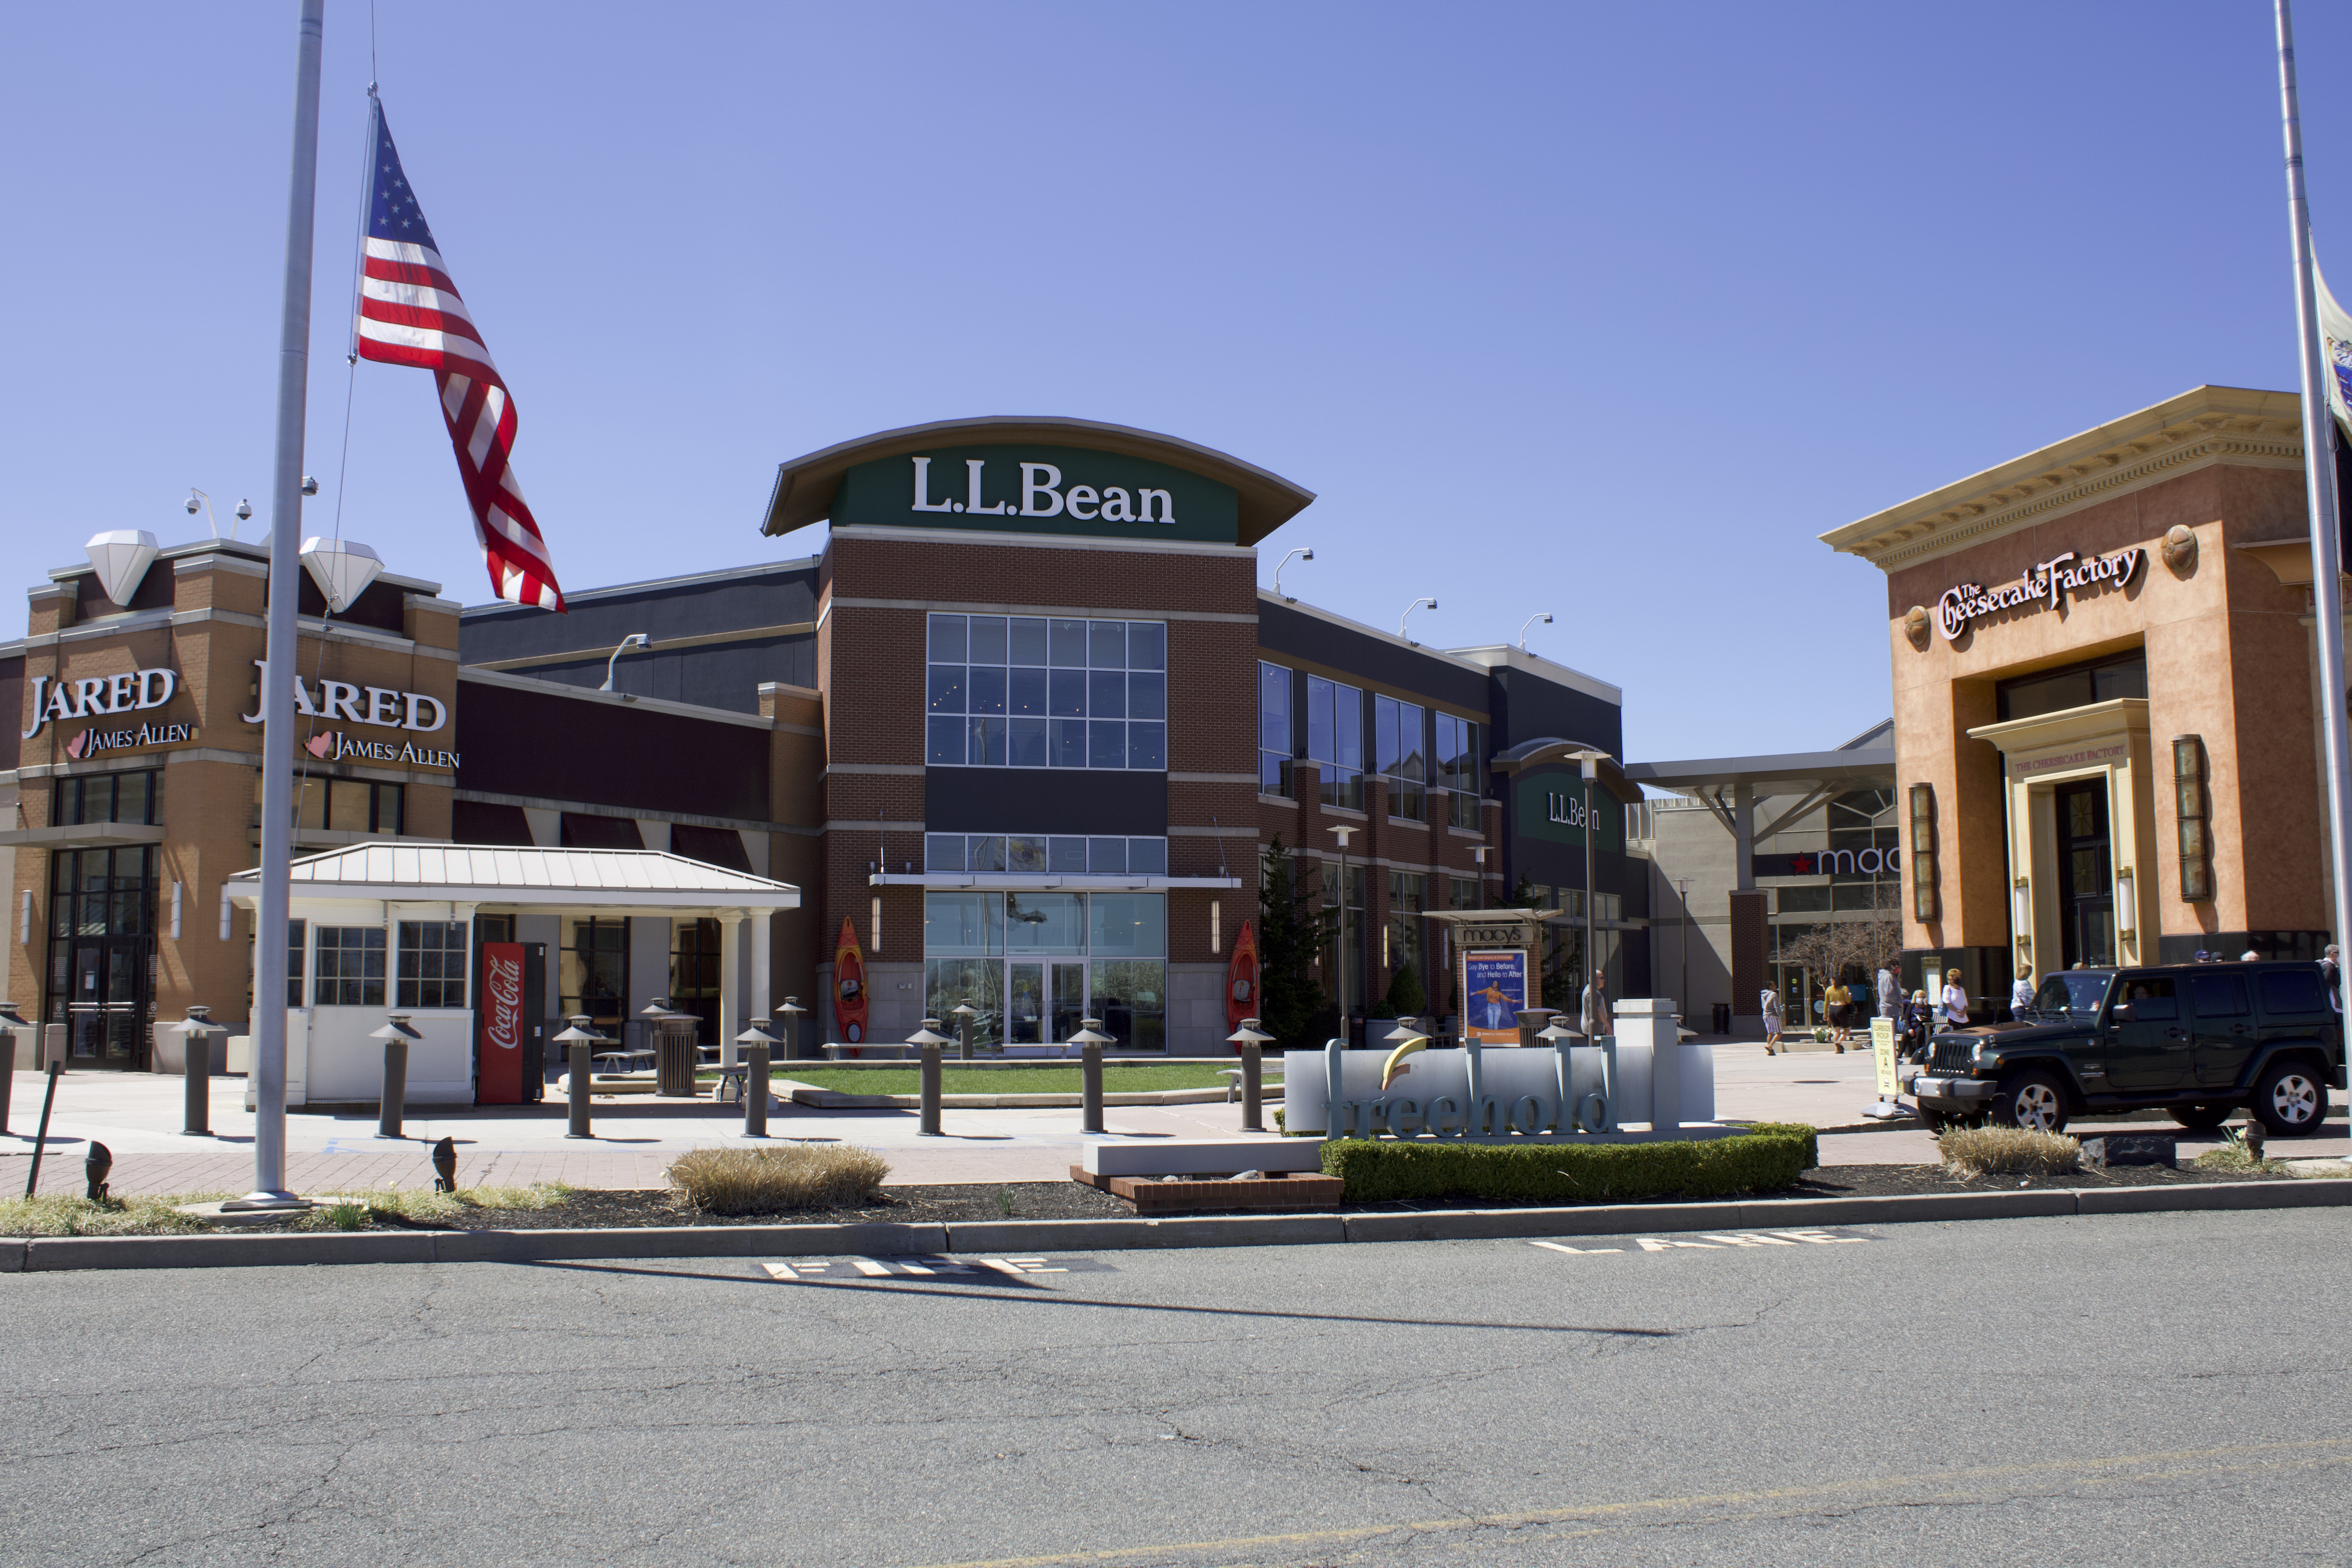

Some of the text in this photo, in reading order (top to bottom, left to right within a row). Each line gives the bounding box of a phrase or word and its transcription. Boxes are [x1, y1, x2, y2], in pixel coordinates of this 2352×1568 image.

[912, 457, 1175, 524] L.L.Bean
[1937, 549, 2145, 640] Cheesecake Factory
[1960, 583, 1981, 599] The
[22, 668, 178, 739] JARED
[85, 722, 190, 758] JAMES ALLEN
[332, 732, 460, 768] JAMES ALLEN
[2015, 745, 2125, 773] THE CHEESECAKE FACTORY
[1549, 792, 1600, 830] L.L.Ben
[1463, 925, 1521, 944] macy's
[488, 953, 519, 1049] Coca-Cola
[1883, 1056, 1888, 1068] A
[1321, 1036, 1623, 1140] freehold
[762, 1230, 1870, 1279] FIRE LANE
